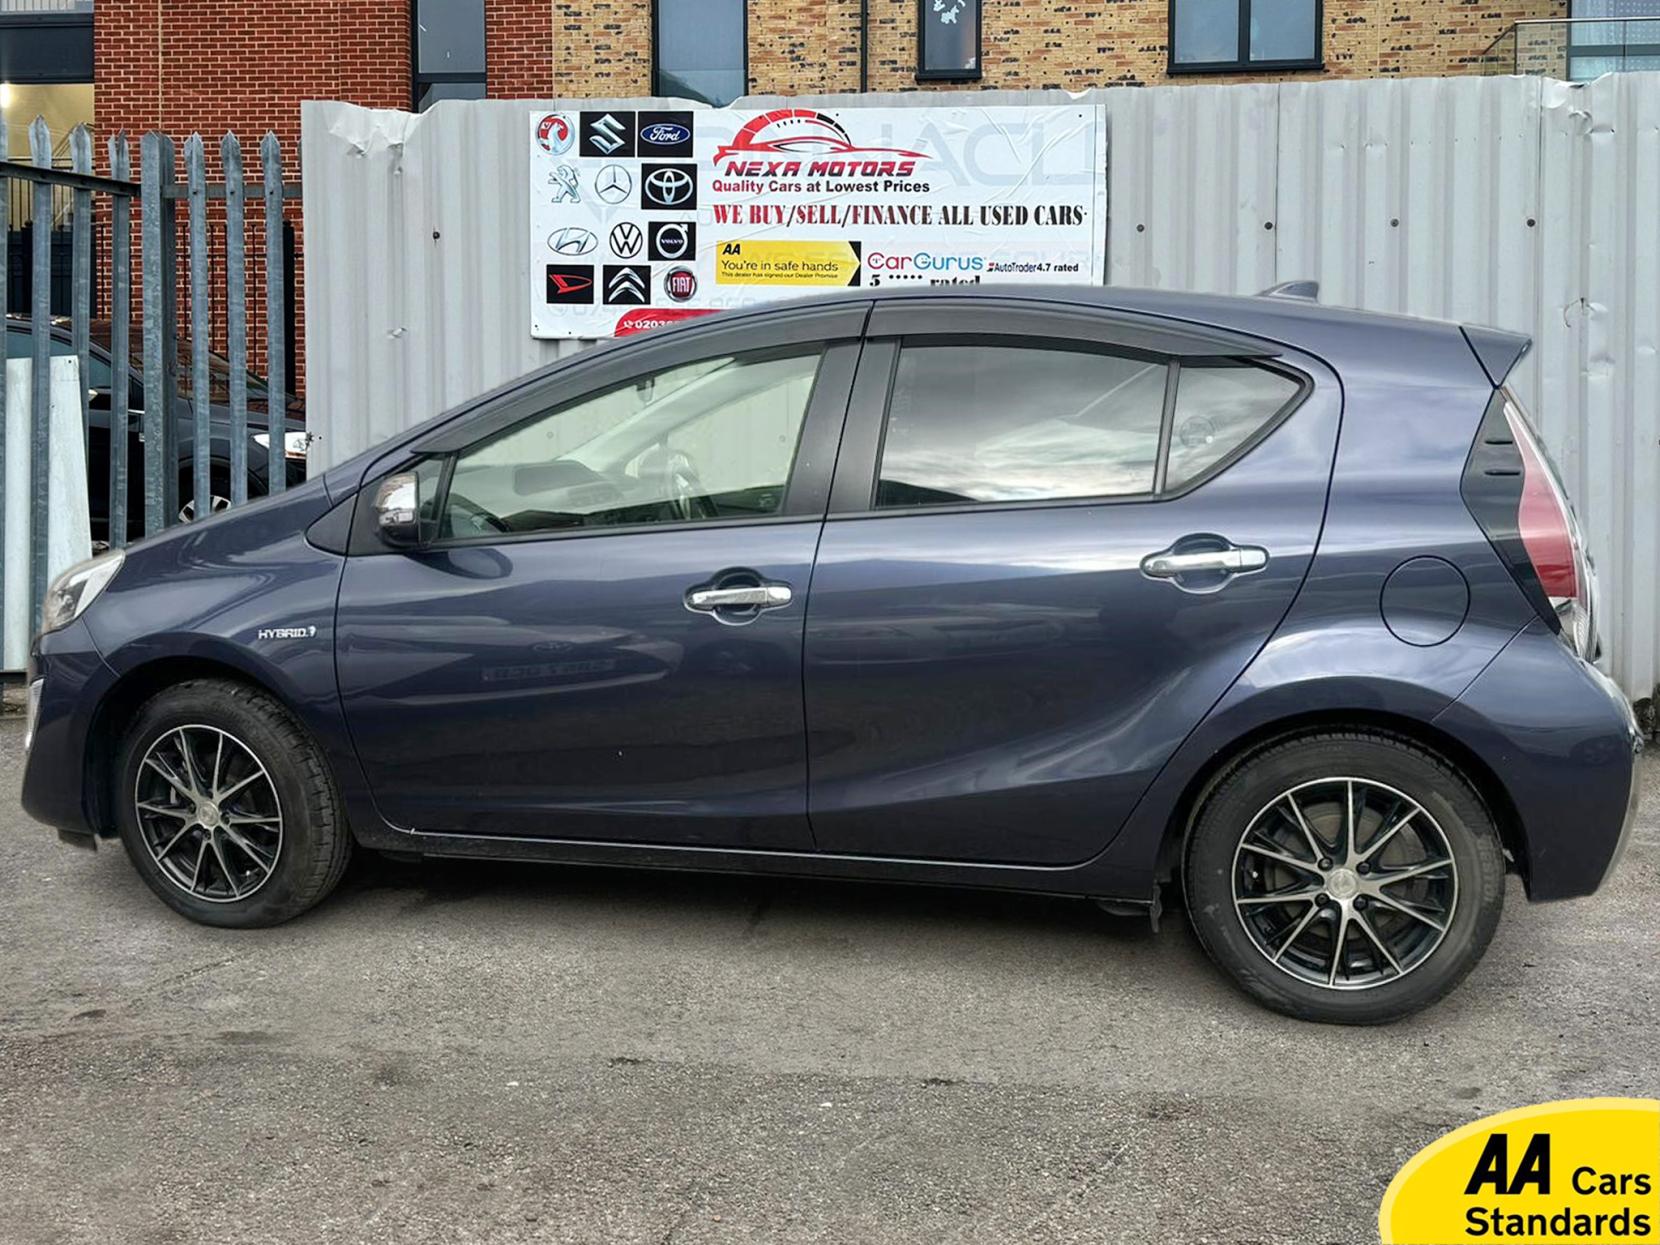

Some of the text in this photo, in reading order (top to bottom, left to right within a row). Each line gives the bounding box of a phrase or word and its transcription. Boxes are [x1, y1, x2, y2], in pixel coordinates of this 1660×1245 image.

[650, 127, 680, 141] Ford
[724, 161, 916, 177] NEXA MOTORS
[712, 179, 930, 195] Quality Cars at Lowest Prices
[712, 204, 743, 224] WE
[938, 205, 974, 225] ALL
[980, 205, 1029, 226] USED
[722, 243, 741, 255] AA
[721, 260, 839, 271] You're in safe hands
[867, 252, 984, 270] CarGurus
[1054, 263, 1079, 272] rated
[672, 277, 691, 293] FIAT
[869, 274, 881, 287] 5
